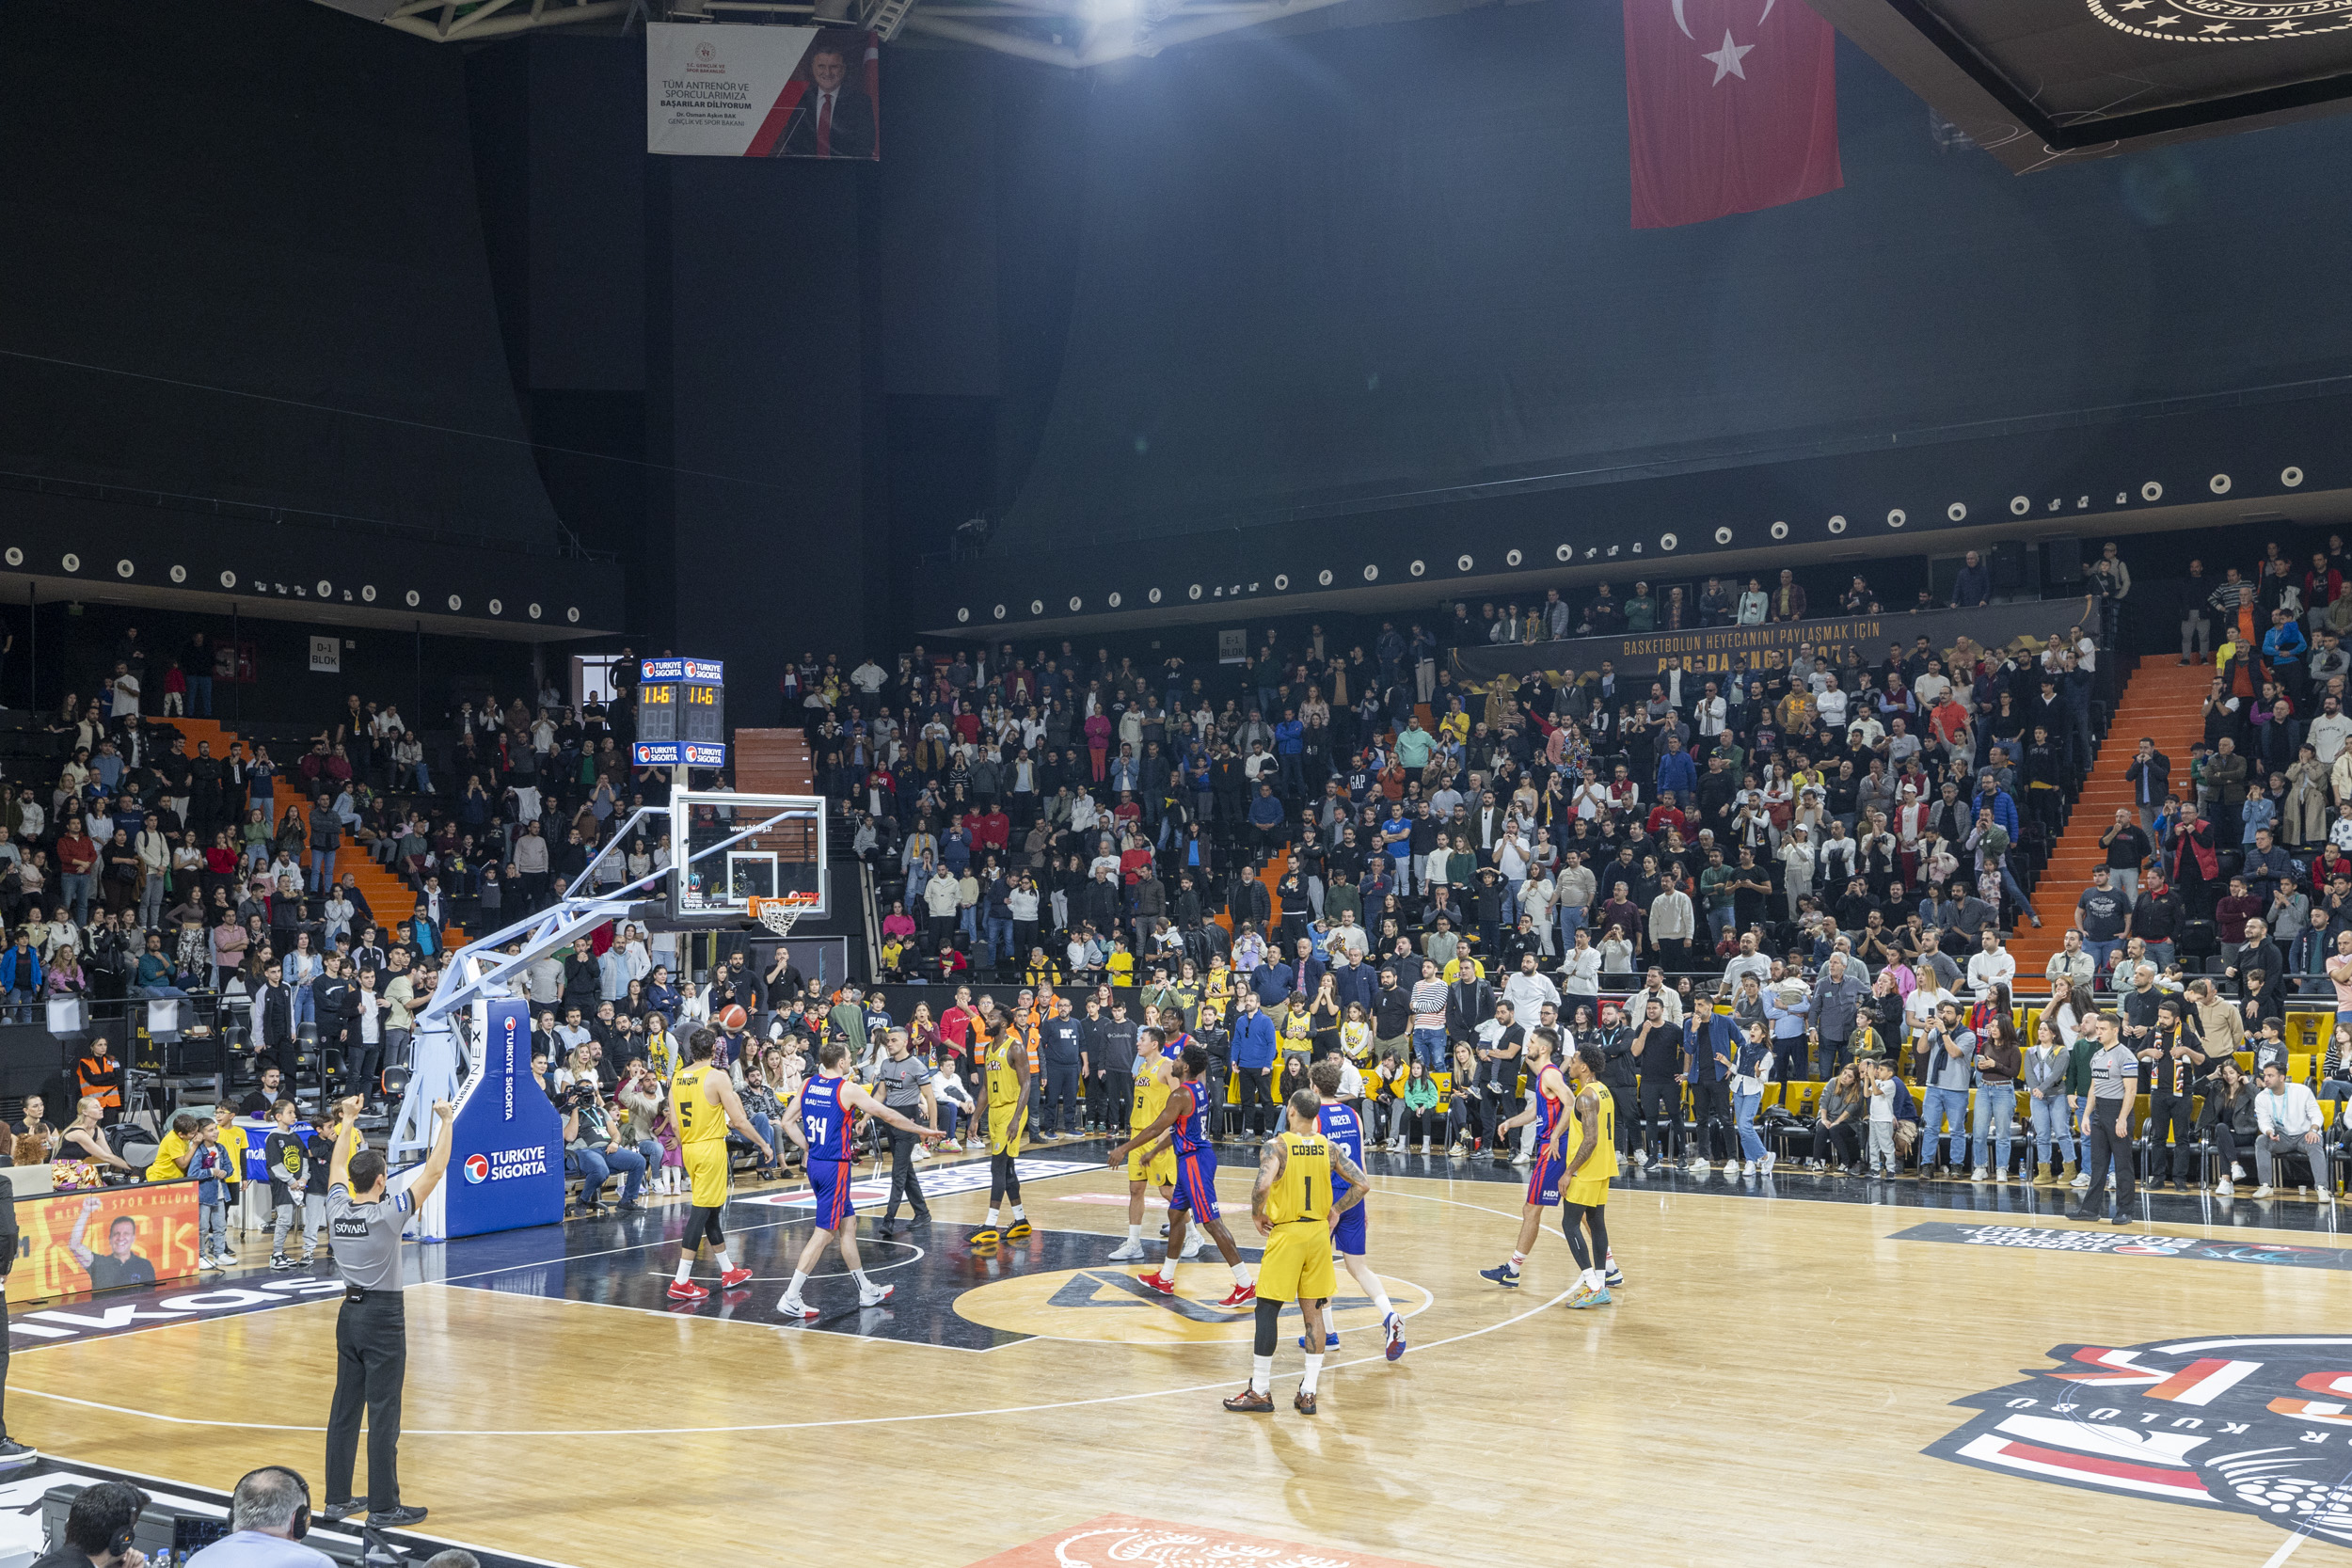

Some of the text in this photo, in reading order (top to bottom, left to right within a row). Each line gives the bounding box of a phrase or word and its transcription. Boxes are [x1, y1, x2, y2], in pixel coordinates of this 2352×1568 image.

[662, 80, 750, 91] TÜM ANTRENÖR VE
[665, 89, 747, 101] SPORCULARIMIZA
[660, 100, 752, 110] BAŞARILAR DİLİYORUM
[668, 118, 694, 126] GENÇLİK
[317, 642, 332, 653] D-1
[1226, 636, 1239, 645] E-1
[1624, 622, 1880, 657] BASKETBOLUN HEYECANINI PAYLAŞMAK İÇİN
[1221, 647, 1244, 657] BLOK
[311, 655, 337, 666] BLOK
[1350, 774, 1365, 790] GAP
[471, 1018, 482, 1076] NEXT
[451, 1079, 474, 1115] orusan
[1137, 1096, 1144, 1108] 9
[679, 1101, 692, 1128] 5
[805, 1115, 827, 1146] 34
[491, 1146, 546, 1165] TÜRKİYE
[491, 1161, 547, 1180] SİGORTA
[112, 1196, 143, 1210] SPOR
[151, 1192, 198, 1205] KULÜBÜ
[1304, 1176, 1311, 1212] 1
[1543, 1190, 1559, 1198] HDI
[2005, 1398, 2251, 1435] KULÜBÜ
